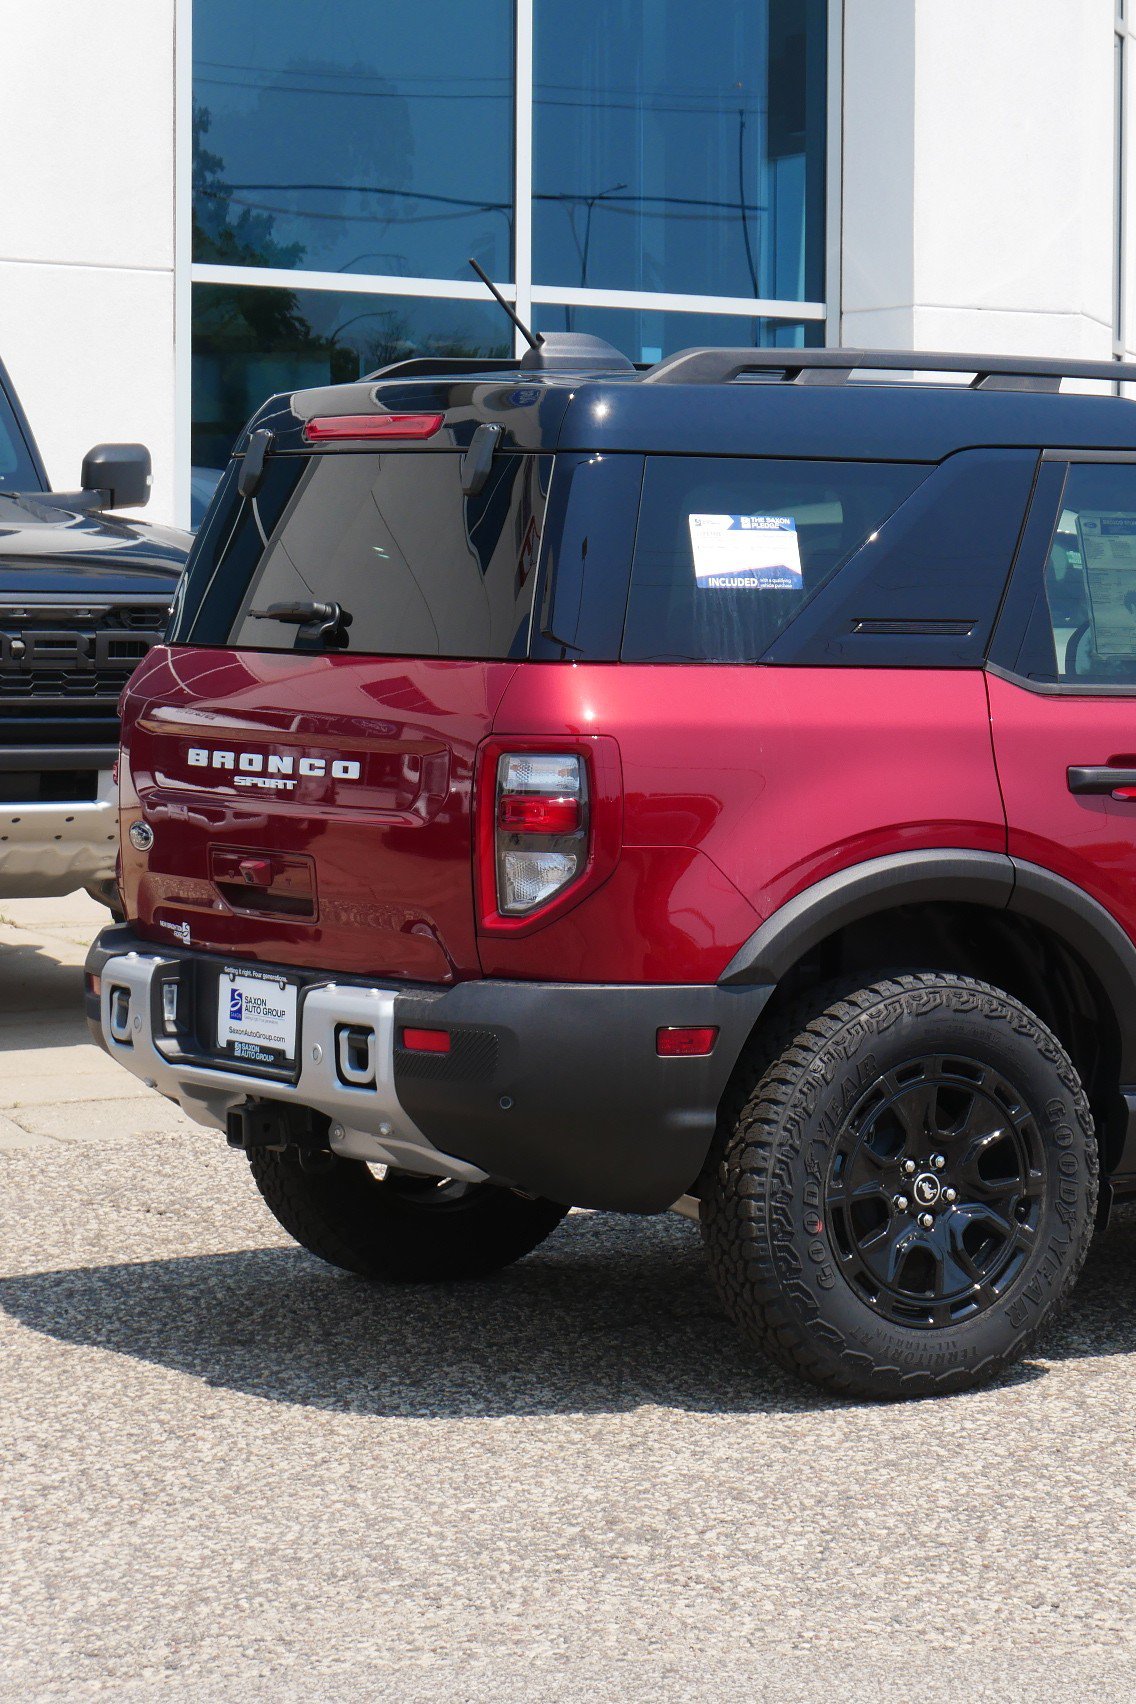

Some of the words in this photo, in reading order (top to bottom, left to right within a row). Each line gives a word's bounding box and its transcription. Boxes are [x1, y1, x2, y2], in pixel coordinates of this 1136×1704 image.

[708, 577, 758, 587] INCLUDED
[0, 631, 164, 669] RD
[187, 748, 361, 780] BRONCO
[233, 775, 298, 790] SPORT
[252, 970, 262, 978] Four
[244, 995, 267, 1007] SAXON
[244, 1005, 262, 1015] AUTO
[262, 1007, 286, 1018] GROUP
[228, 1026, 286, 1043] SaxonAutoGroup.com
[241, 1043, 260, 1052] SAXON
[241, 1050, 255, 1059] AUTO
[255, 1052, 274, 1061] GROUP
